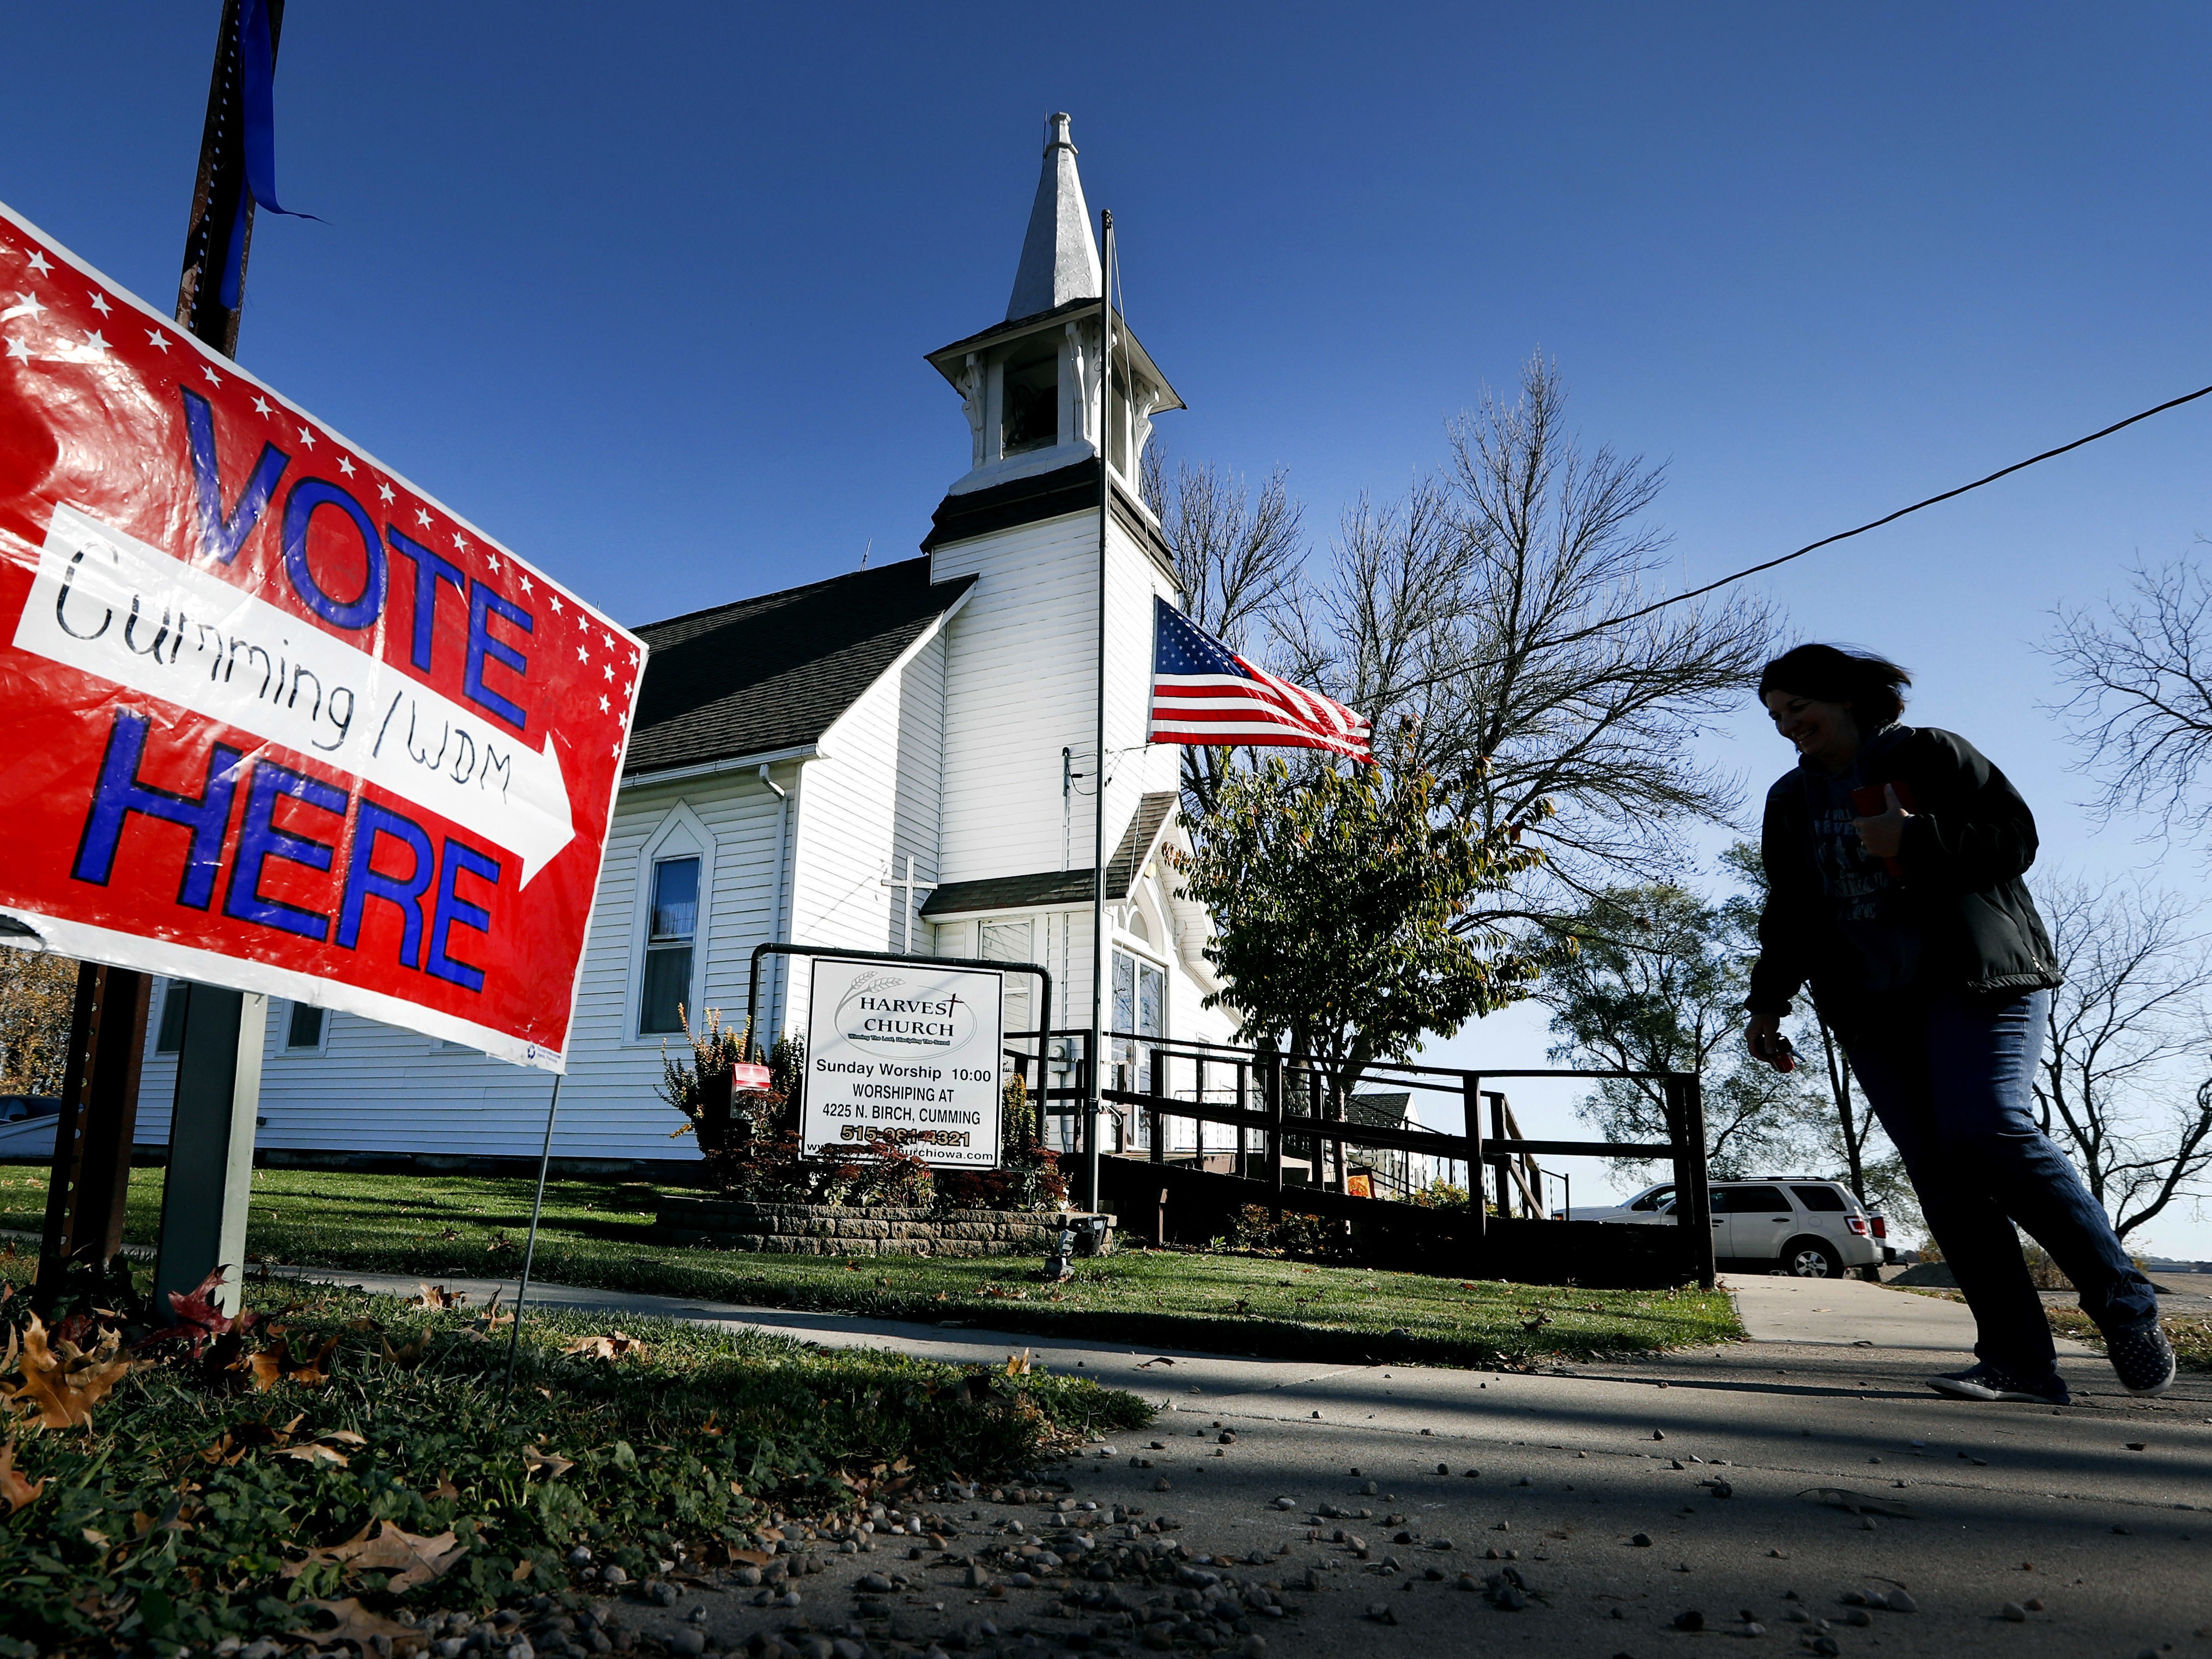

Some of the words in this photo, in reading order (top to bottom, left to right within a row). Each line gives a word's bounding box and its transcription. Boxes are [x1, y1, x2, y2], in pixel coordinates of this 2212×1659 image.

[179, 383, 533, 731] VOTE
[56, 541, 354, 751] Cumming
[372, 689, 511, 804] /WDM
[70, 706, 500, 994] HERE
[860, 993, 965, 1019] HARVEST
[864, 1018, 954, 1037] CHURCH
[816, 1059, 874, 1077] Sunday
[879, 1063, 942, 1082] Worship
[952, 1069, 991, 1082] 10:00
[853, 1083, 935, 1101] WORSHIPING
[938, 1089, 954, 1103] AT
[822, 1104, 851, 1117] 4225
[856, 1105, 868, 1118] N.
[872, 1105, 915, 1124] BIRCH,
[919, 1108, 980, 1125] CUMMING
